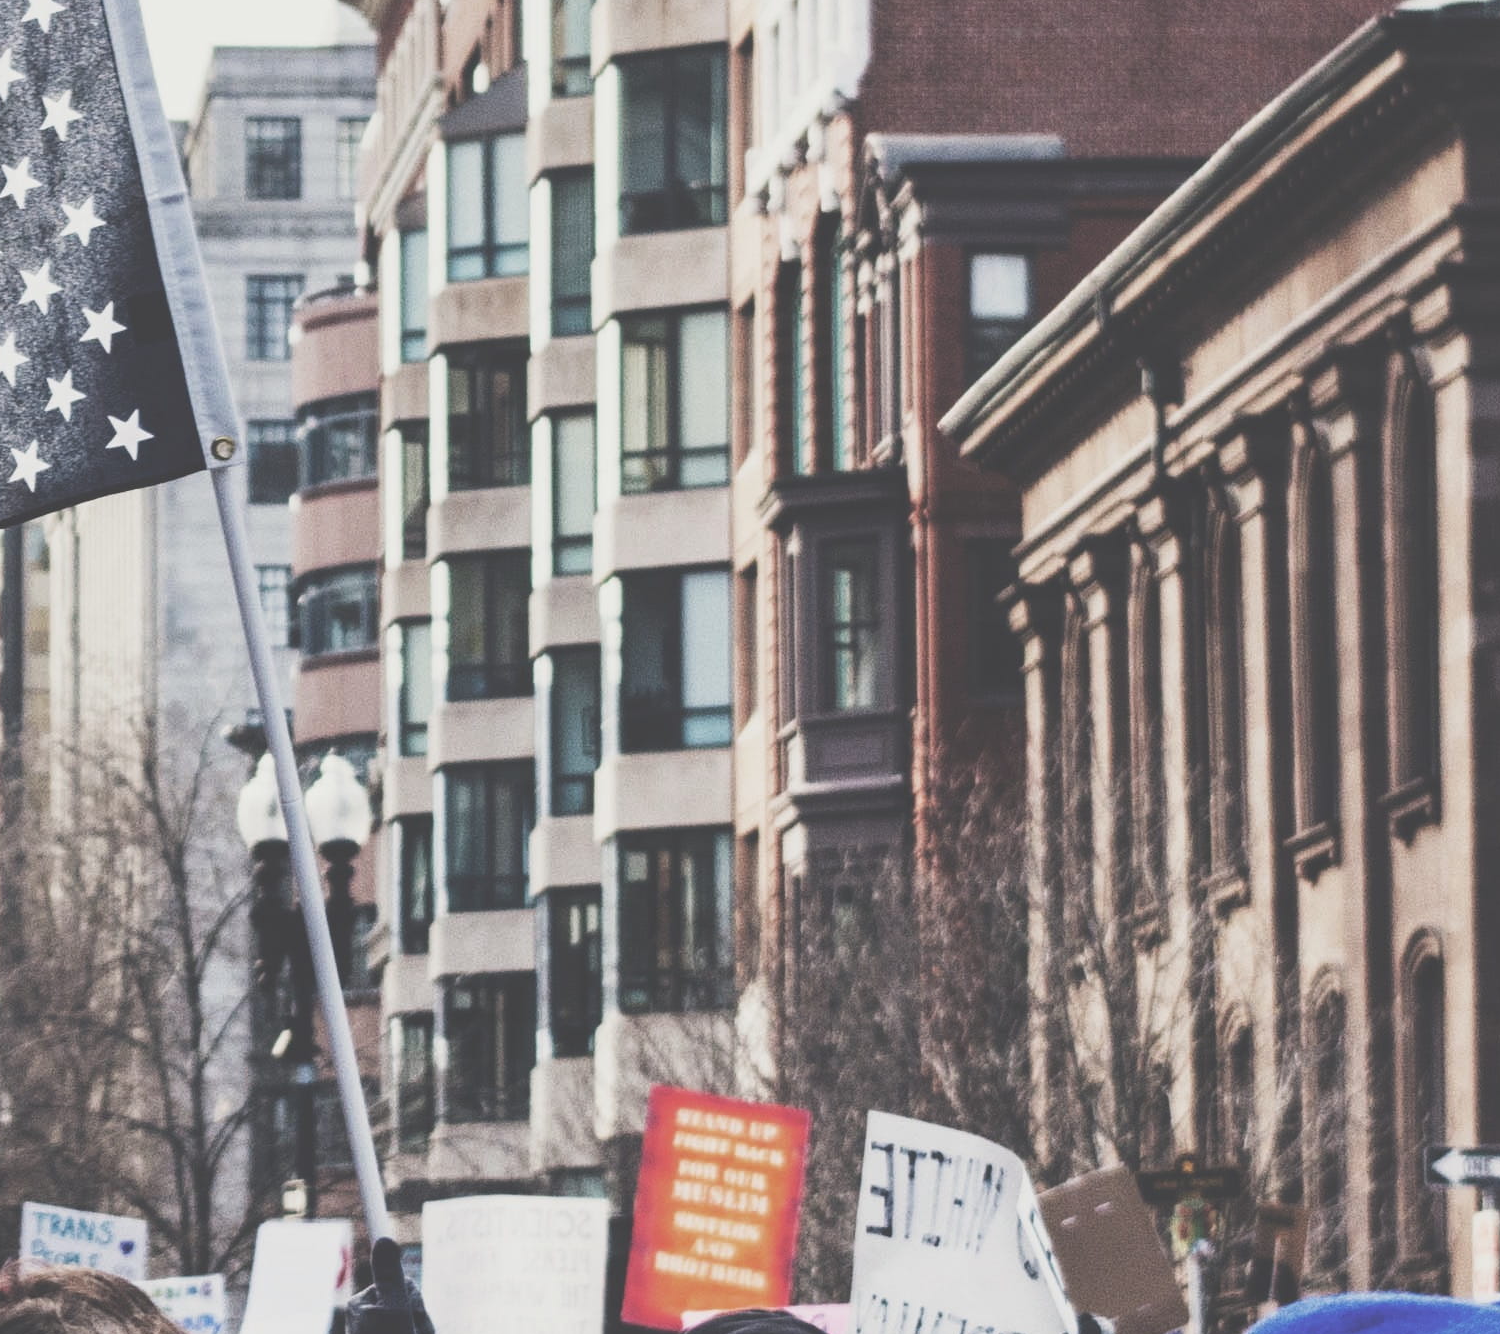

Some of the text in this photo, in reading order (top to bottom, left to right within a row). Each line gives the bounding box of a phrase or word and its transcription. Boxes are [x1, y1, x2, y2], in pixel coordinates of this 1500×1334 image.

[675, 1107, 780, 1141] STAND UP
[678, 1158, 767, 1192] FOR OUR
[672, 1179, 770, 1216] MUSLIM
[31, 1211, 114, 1246] TRANS
[690, 1236, 737, 1260] AND
[654, 1250, 768, 1291] BROTHERS
